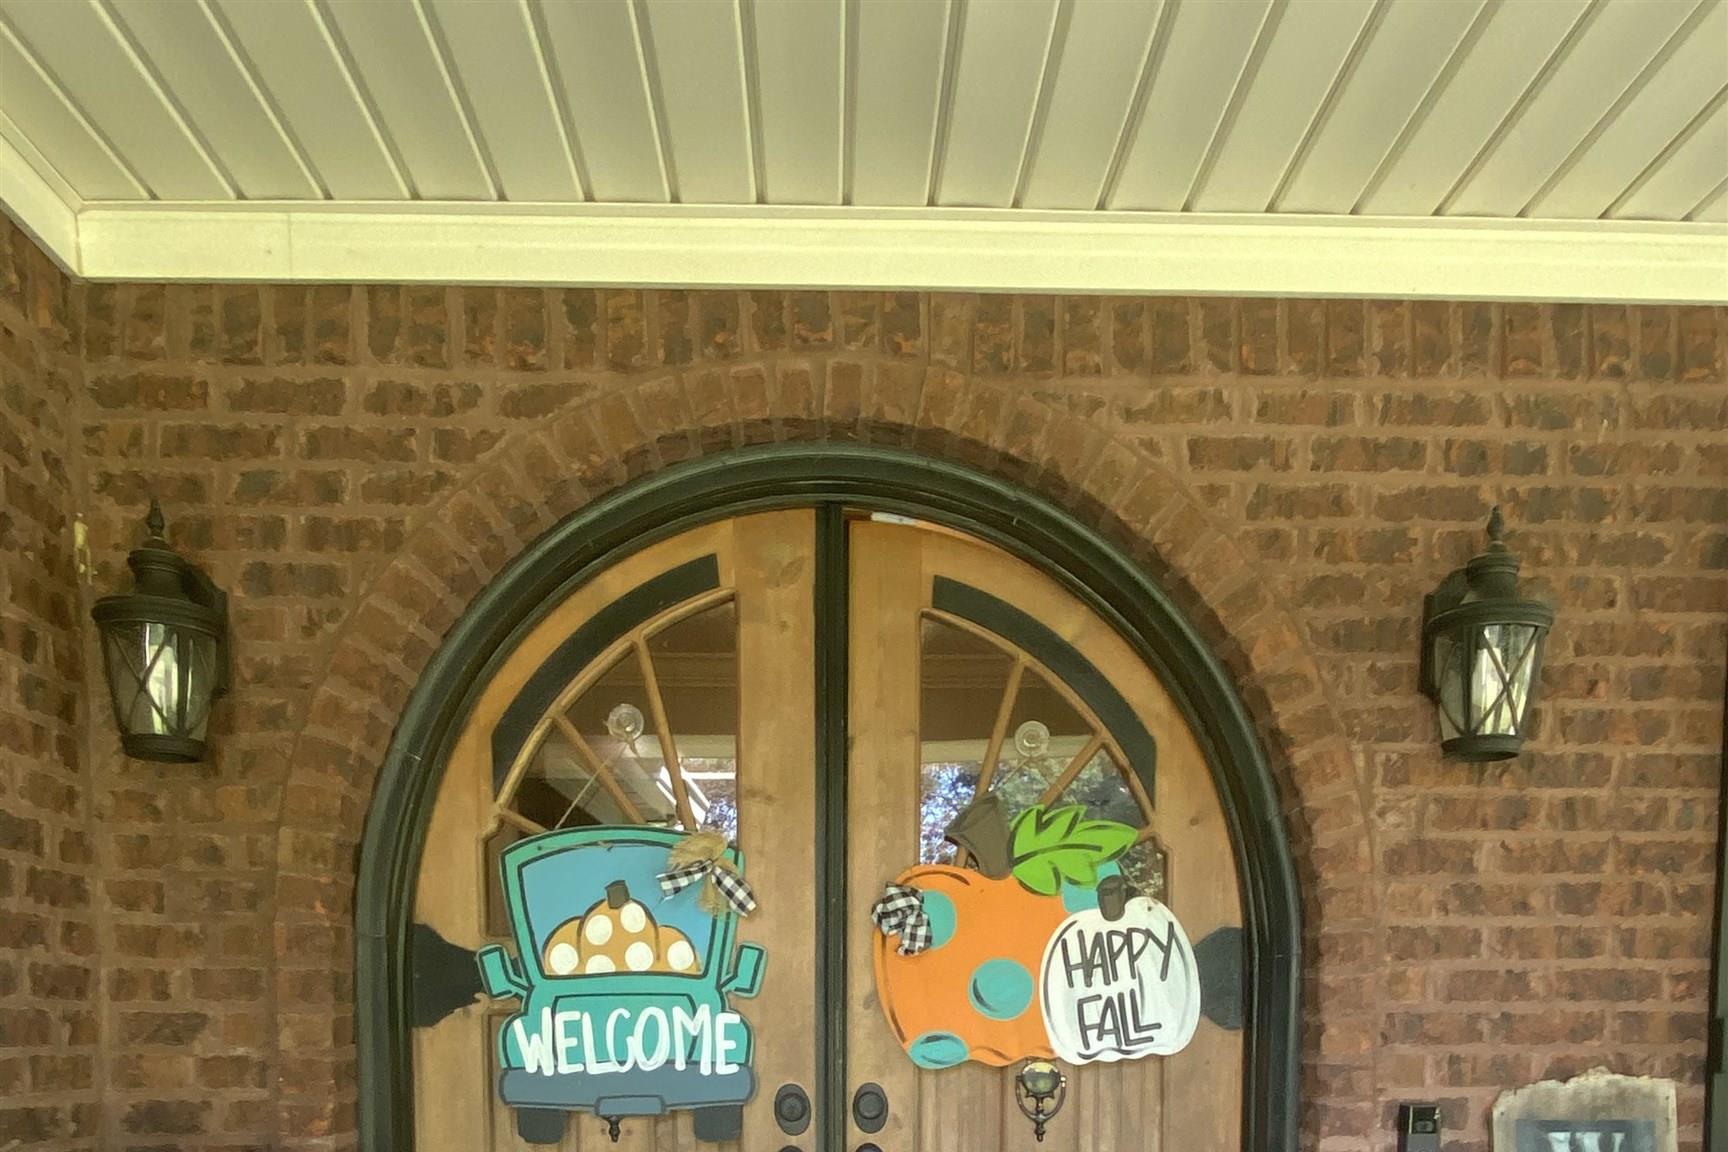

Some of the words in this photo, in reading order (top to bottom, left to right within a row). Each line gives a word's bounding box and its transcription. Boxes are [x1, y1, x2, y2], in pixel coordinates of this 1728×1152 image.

[1061, 921, 1174, 988] HAPPY
[512, 1004, 741, 1076] WELCOME
[1076, 988, 1162, 1050] FALL
